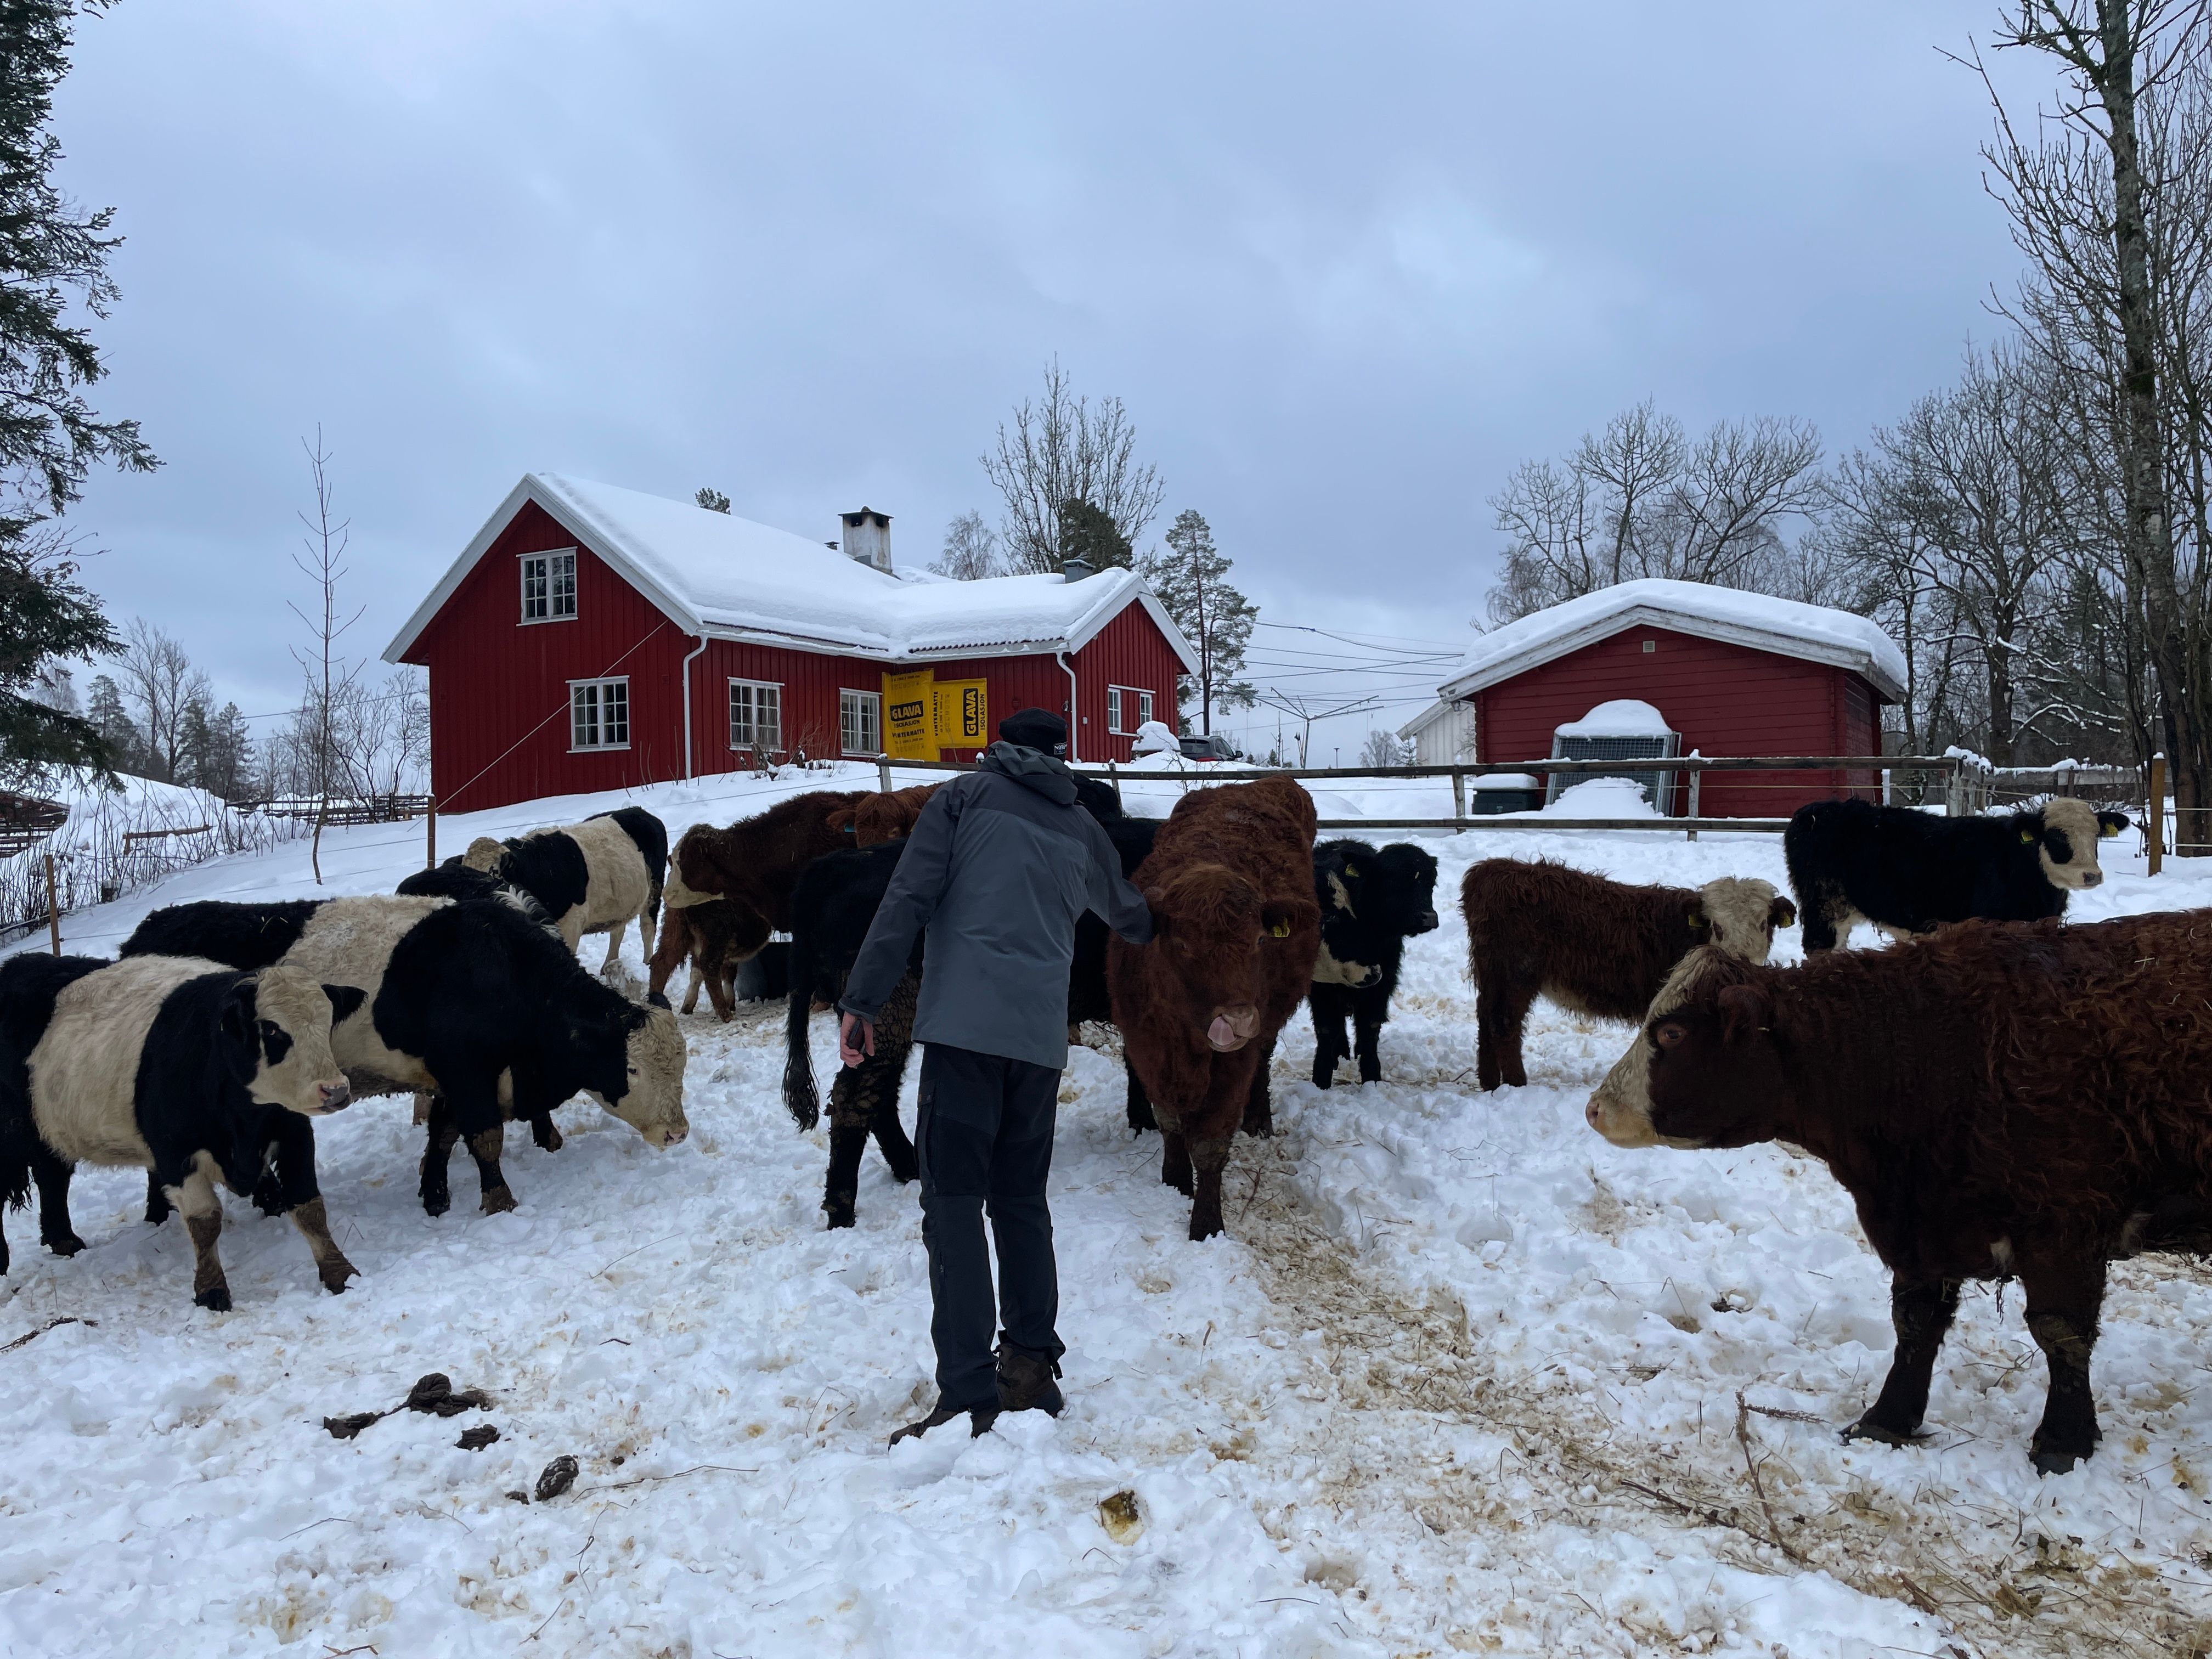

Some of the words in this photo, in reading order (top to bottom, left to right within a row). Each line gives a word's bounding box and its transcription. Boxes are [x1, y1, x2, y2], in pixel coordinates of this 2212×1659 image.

[892, 704, 922, 719] GLAVA
[966, 691, 977, 735] GLAVA
[894, 720, 920, 729] ISOLASJON
[892, 729, 925, 738] VINTERMATTE
